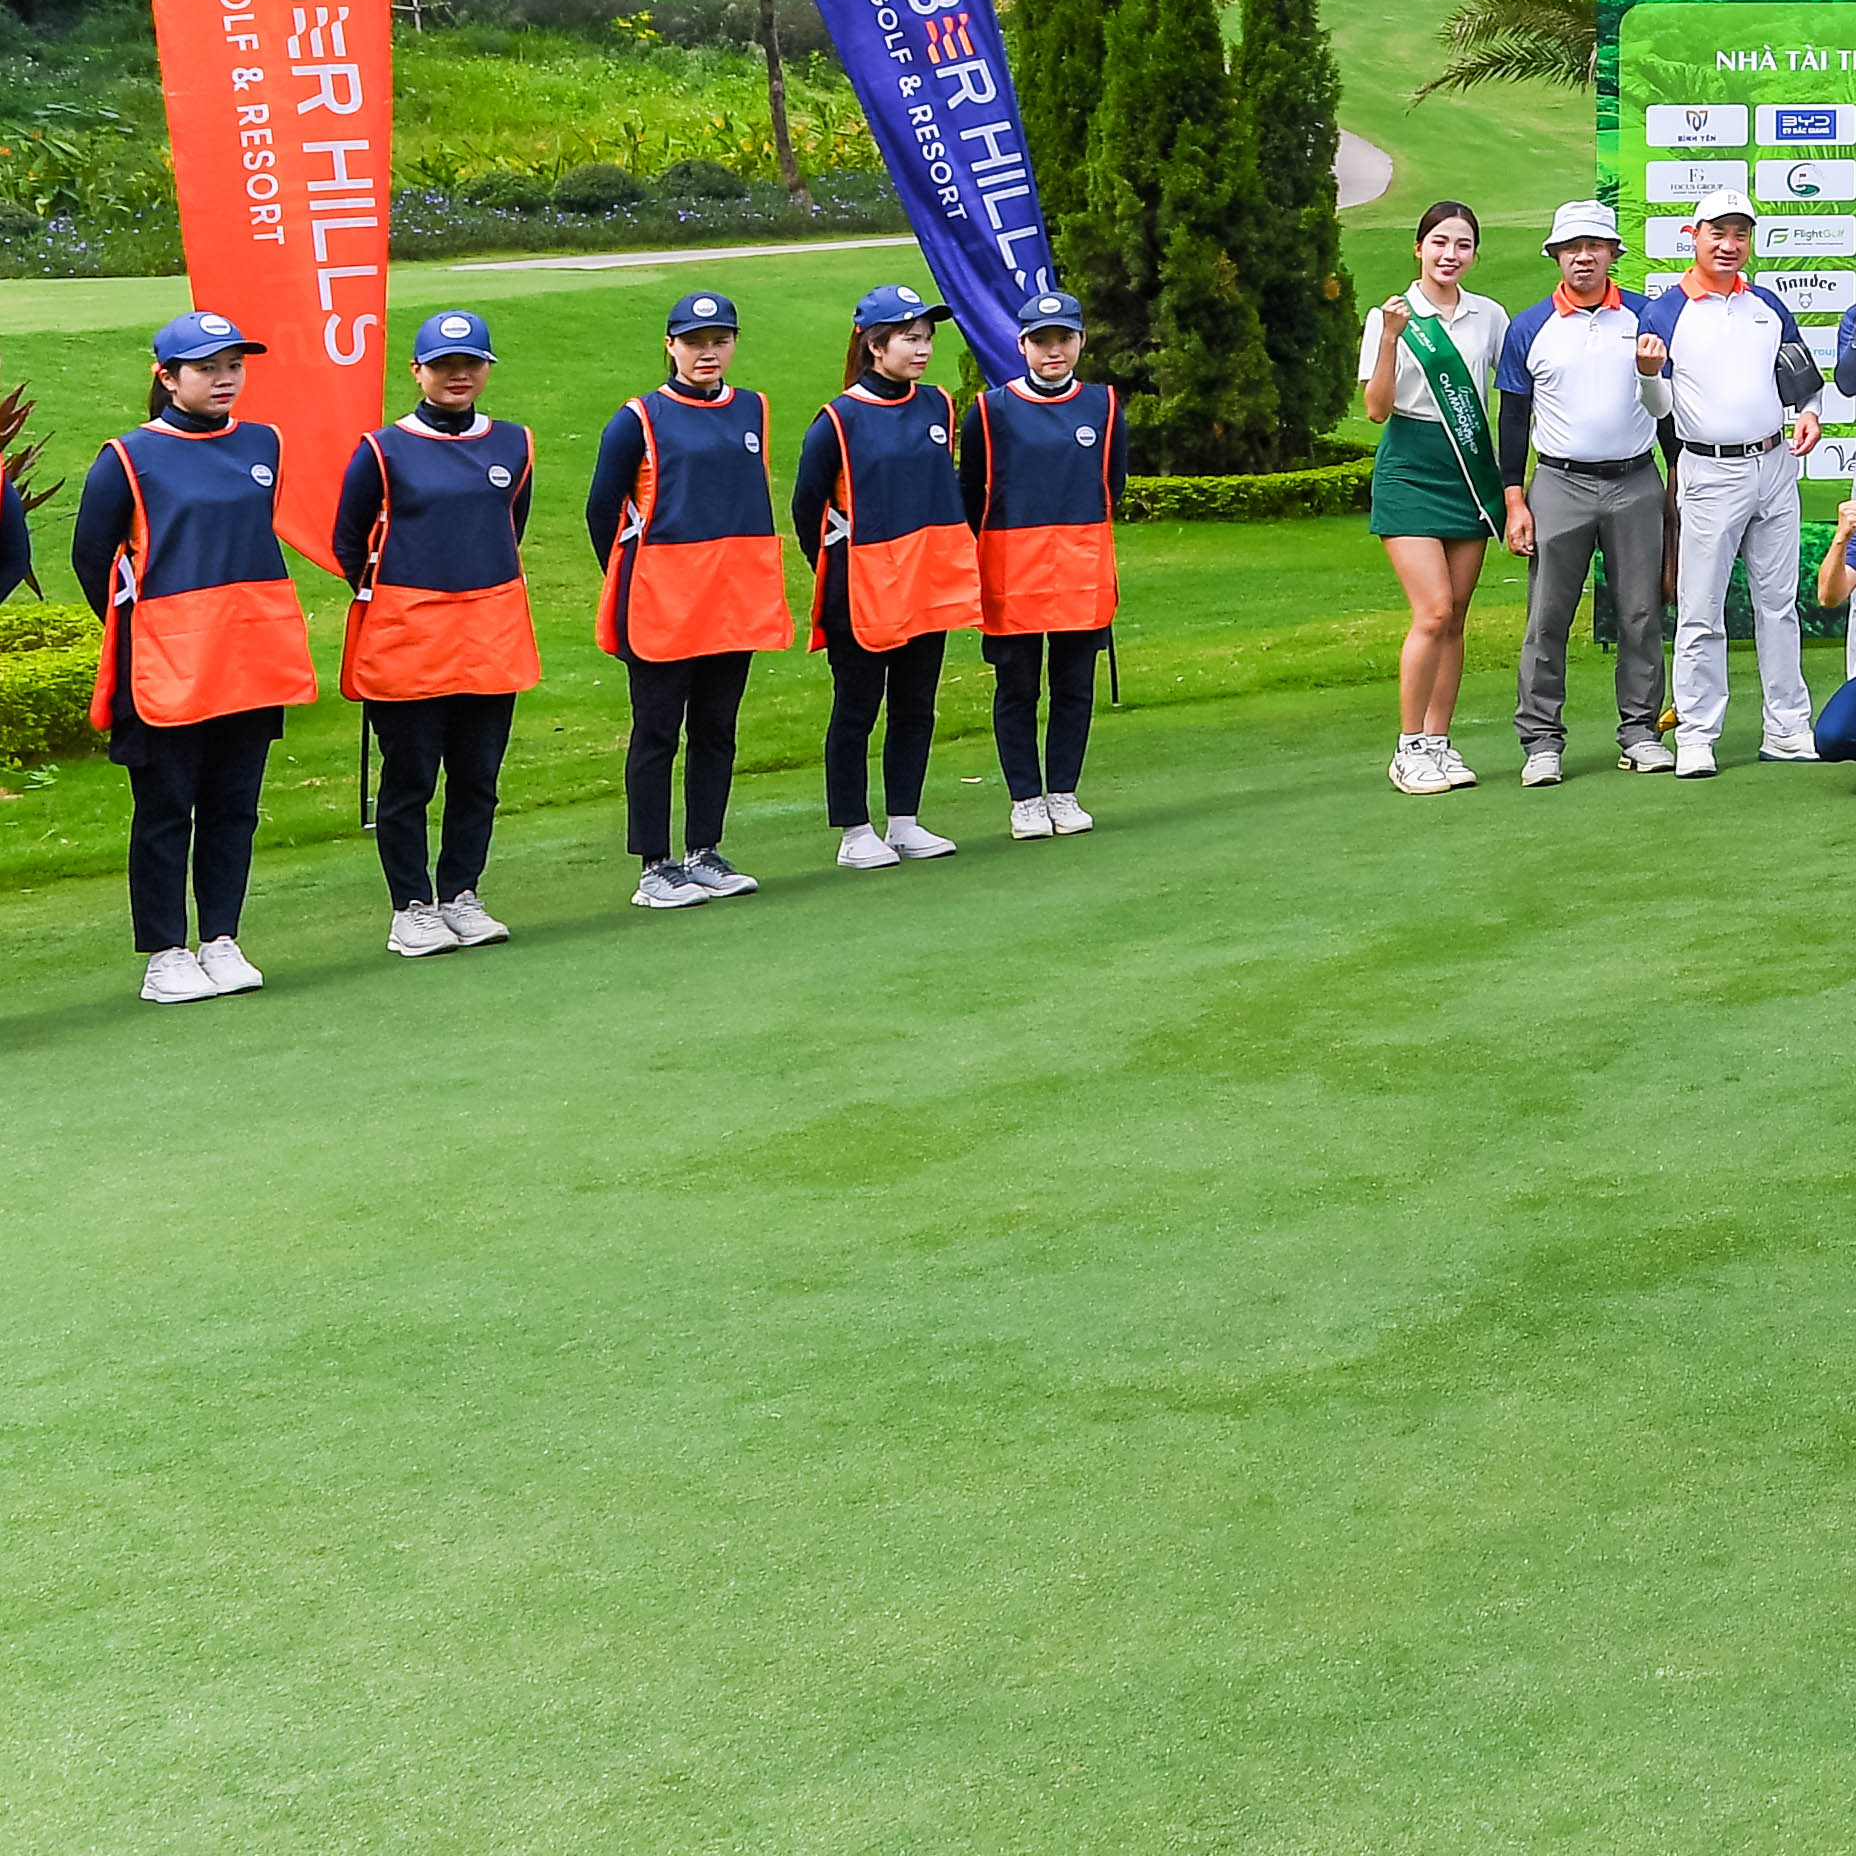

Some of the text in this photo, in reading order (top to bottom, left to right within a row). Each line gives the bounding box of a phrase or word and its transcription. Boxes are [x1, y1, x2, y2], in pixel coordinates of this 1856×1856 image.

[231, 67, 264, 93] &
[899, 73, 921, 98] &
[1716, 44, 1777, 72] NHÀ
[1785, 44, 1828, 71] TÀI
[237, 103, 285, 245] RESORT
[908, 103, 968, 221] RESORT
[302, 139, 379, 366] HILLS
